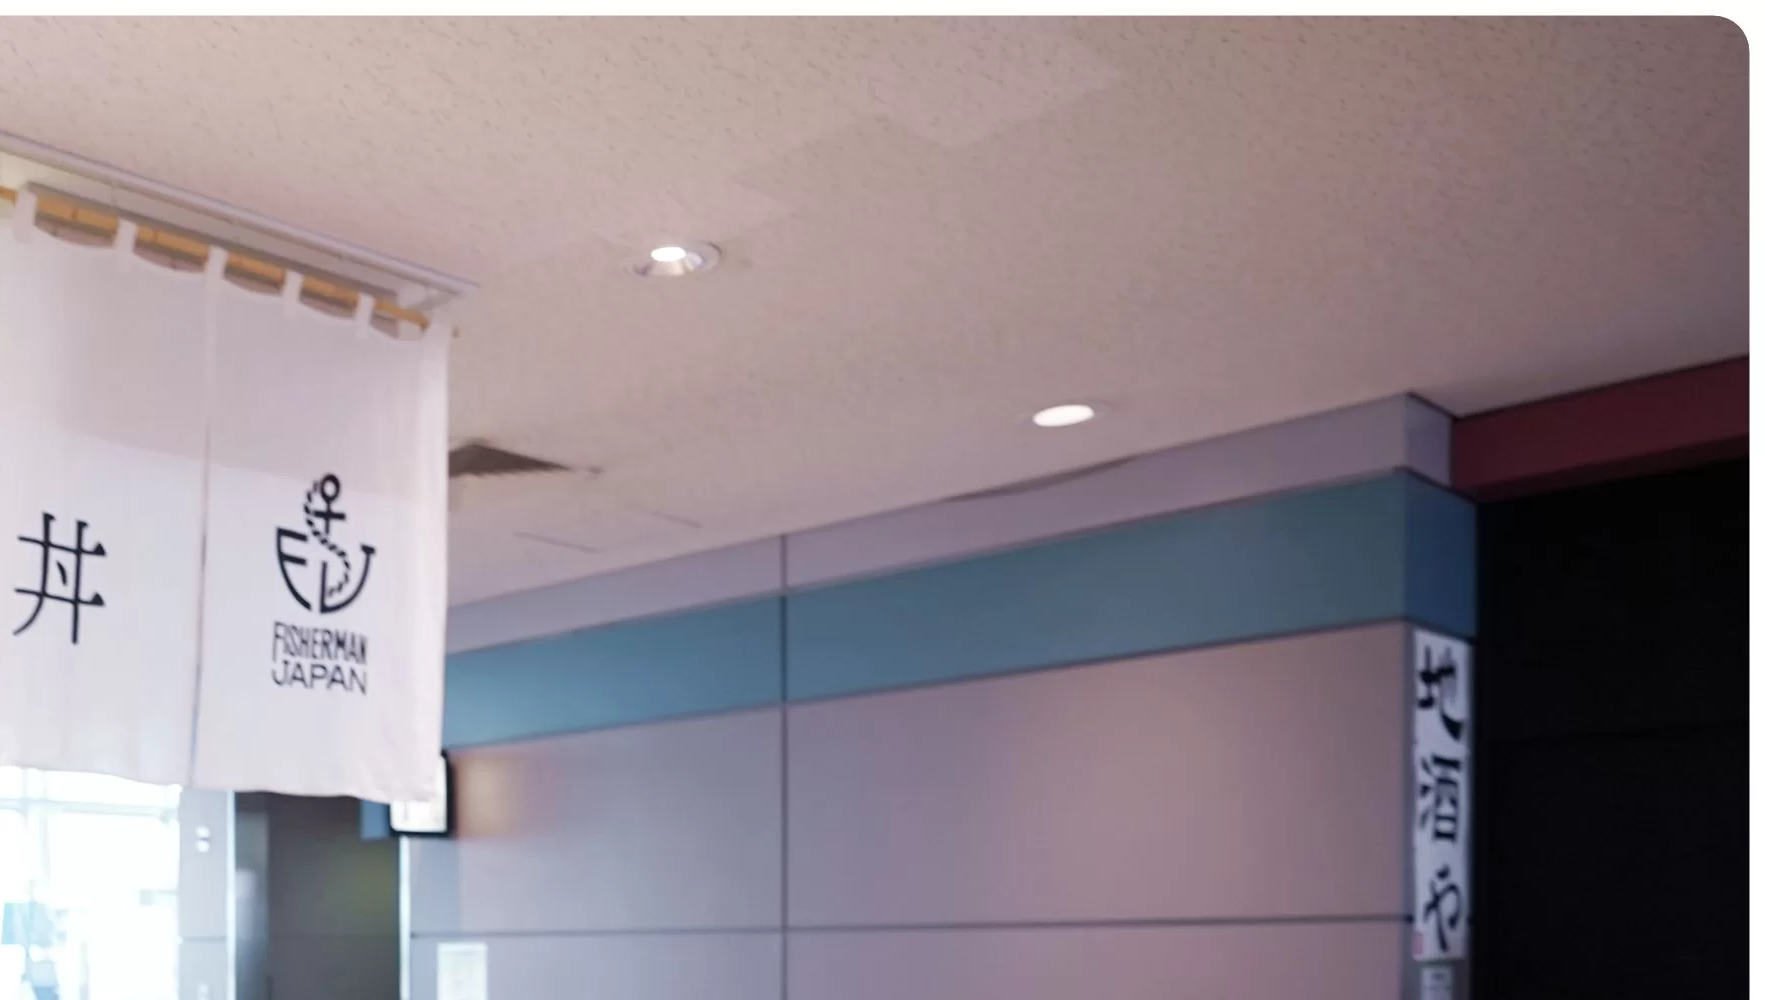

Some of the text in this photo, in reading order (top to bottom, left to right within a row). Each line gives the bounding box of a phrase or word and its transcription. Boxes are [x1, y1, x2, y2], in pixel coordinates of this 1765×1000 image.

[15, 513, 106, 643] 丼
[271, 659, 367, 695] JAPAN
[272, 621, 368, 665] FISHERMAN
[1417, 645, 1467, 952] 地酒や
